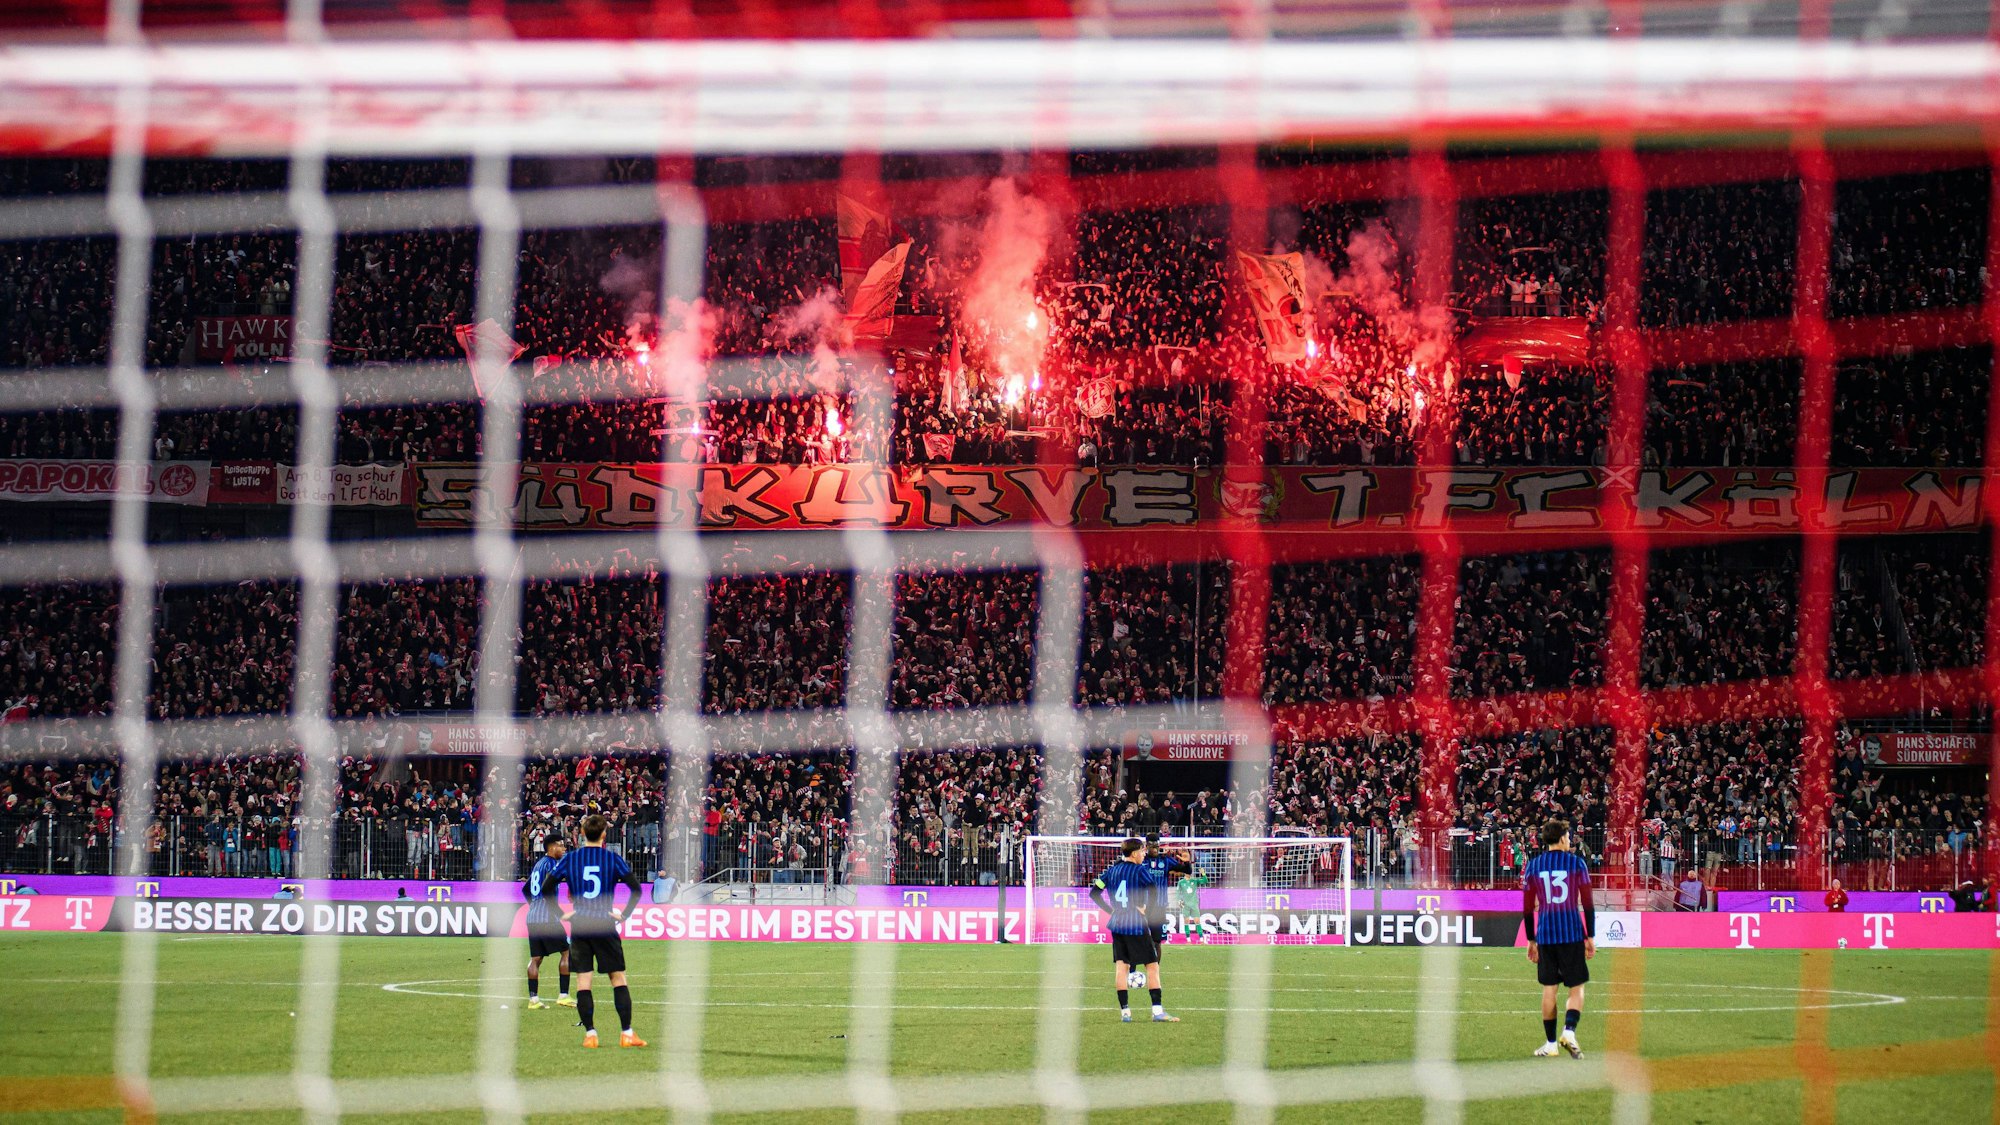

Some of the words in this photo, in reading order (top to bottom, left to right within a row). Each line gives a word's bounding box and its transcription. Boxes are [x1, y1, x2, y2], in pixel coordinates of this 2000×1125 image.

[234, 339, 284, 357] KÖLN
[286, 469, 308, 483] Am
[330, 469, 352, 486] Tag
[357, 466, 396, 483] schuf
[280, 487, 308, 500] Gott
[311, 487, 335, 501] den
[351, 487, 367, 501] FC
[369, 485, 398, 501] Köln
[1632, 470, 1983, 531] KÖLN
[448, 728, 476, 739] HANS
[479, 726, 527, 740] SCHÄFER
[1168, 733, 1196, 745] HANS
[1200, 732, 1248, 746] SCHÄFER
[1896, 737, 1924, 748] HANS
[1928, 735, 1976, 749] SCHÄFER
[448, 740, 503, 753] SÜDKURVE
[1168, 745, 1224, 759] SÜDKURVE
[1896, 748, 1952, 762] SÜDKURVE
[530, 871, 541, 896] 8
[582, 865, 601, 899] 5
[1115, 879, 1128, 908] 4
[1539, 870, 1569, 904] 13
[66, 897, 92, 930] T
[133, 901, 254, 932] BESSER
[262, 903, 305, 933] ZO
[313, 904, 368, 934] DIR
[376, 905, 488, 935] STONN
[752, 908, 782, 940] IM
[792, 909, 922, 941] BESTEN
[932, 911, 1020, 941] NETZ
[1289, 914, 1347, 935] MIT
[1354, 910, 1483, 944] JEFÖHL
[1729, 912, 1760, 948] T
[1863, 912, 1894, 948] T
